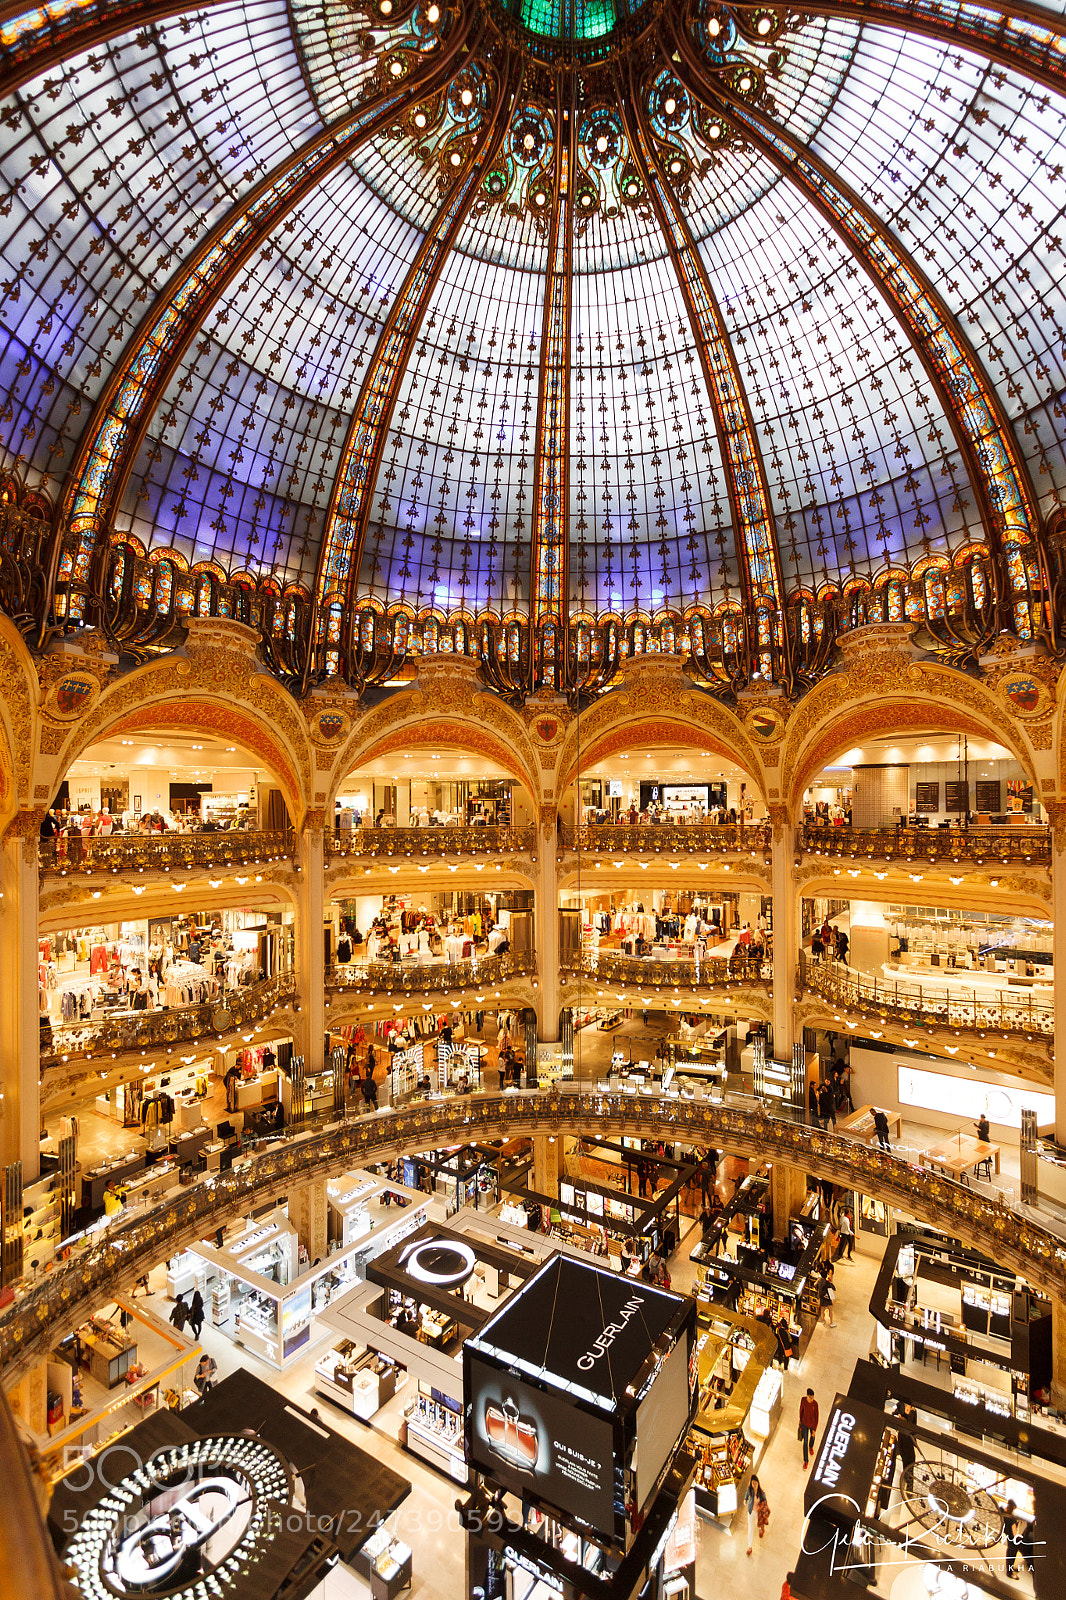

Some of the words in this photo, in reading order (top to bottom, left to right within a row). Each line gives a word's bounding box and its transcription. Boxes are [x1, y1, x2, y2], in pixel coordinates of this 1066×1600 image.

[577, 1295, 645, 1371] GUERLAIN
[554, 1441, 566, 1451] QUI
[821, 1412, 857, 1489] GUERLAIN
[504, 1545, 564, 1593] GUERLAIN
